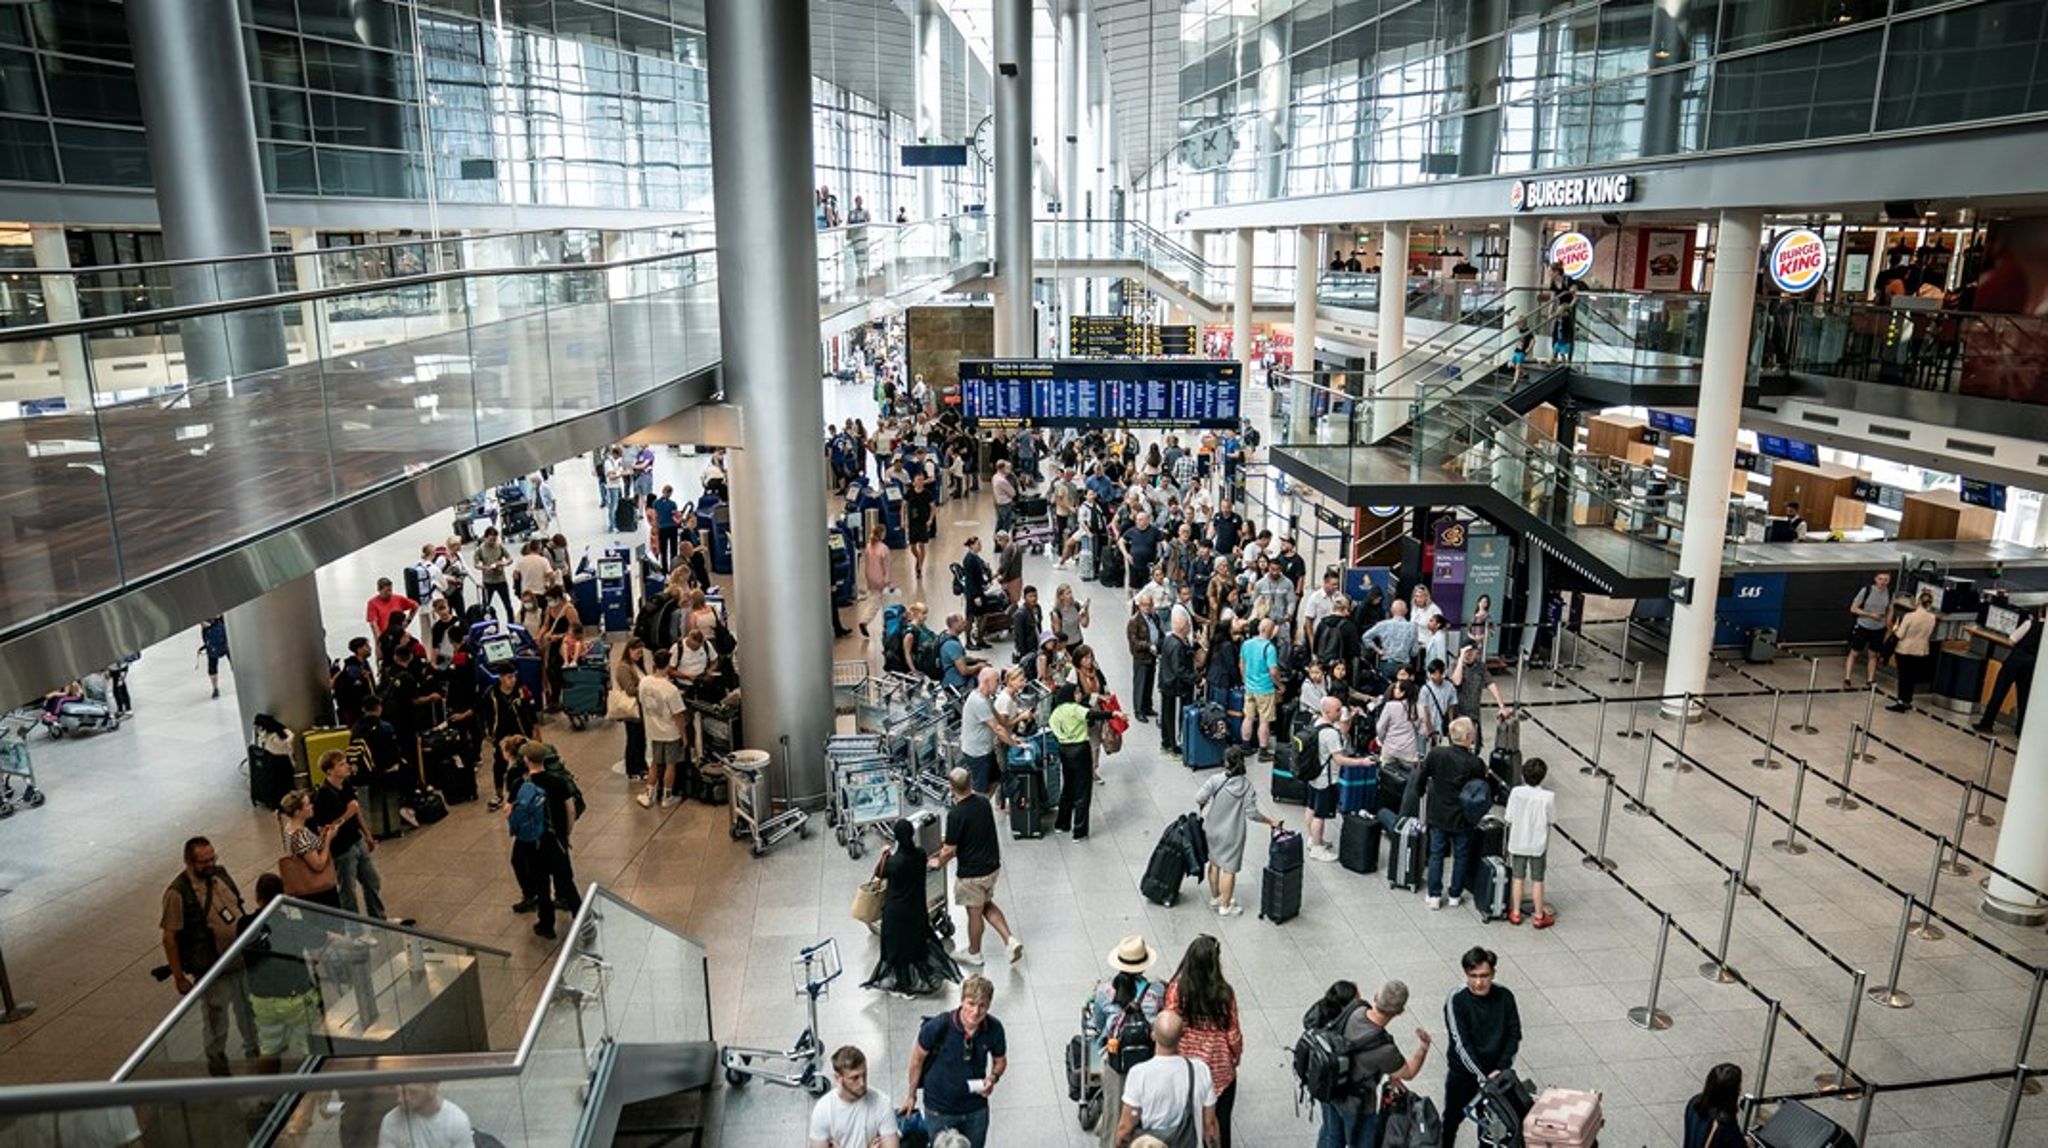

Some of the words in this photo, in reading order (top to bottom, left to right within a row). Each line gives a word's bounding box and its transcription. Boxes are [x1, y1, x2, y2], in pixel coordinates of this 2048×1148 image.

[1527, 178, 1584, 207] BURGER
[1585, 174, 1628, 203] KING
[1556, 241, 1587, 257] BURGER
[1779, 242, 1822, 263] BURGER
[1779, 252, 1821, 277] KING
[1737, 586, 1764, 598] SAS
